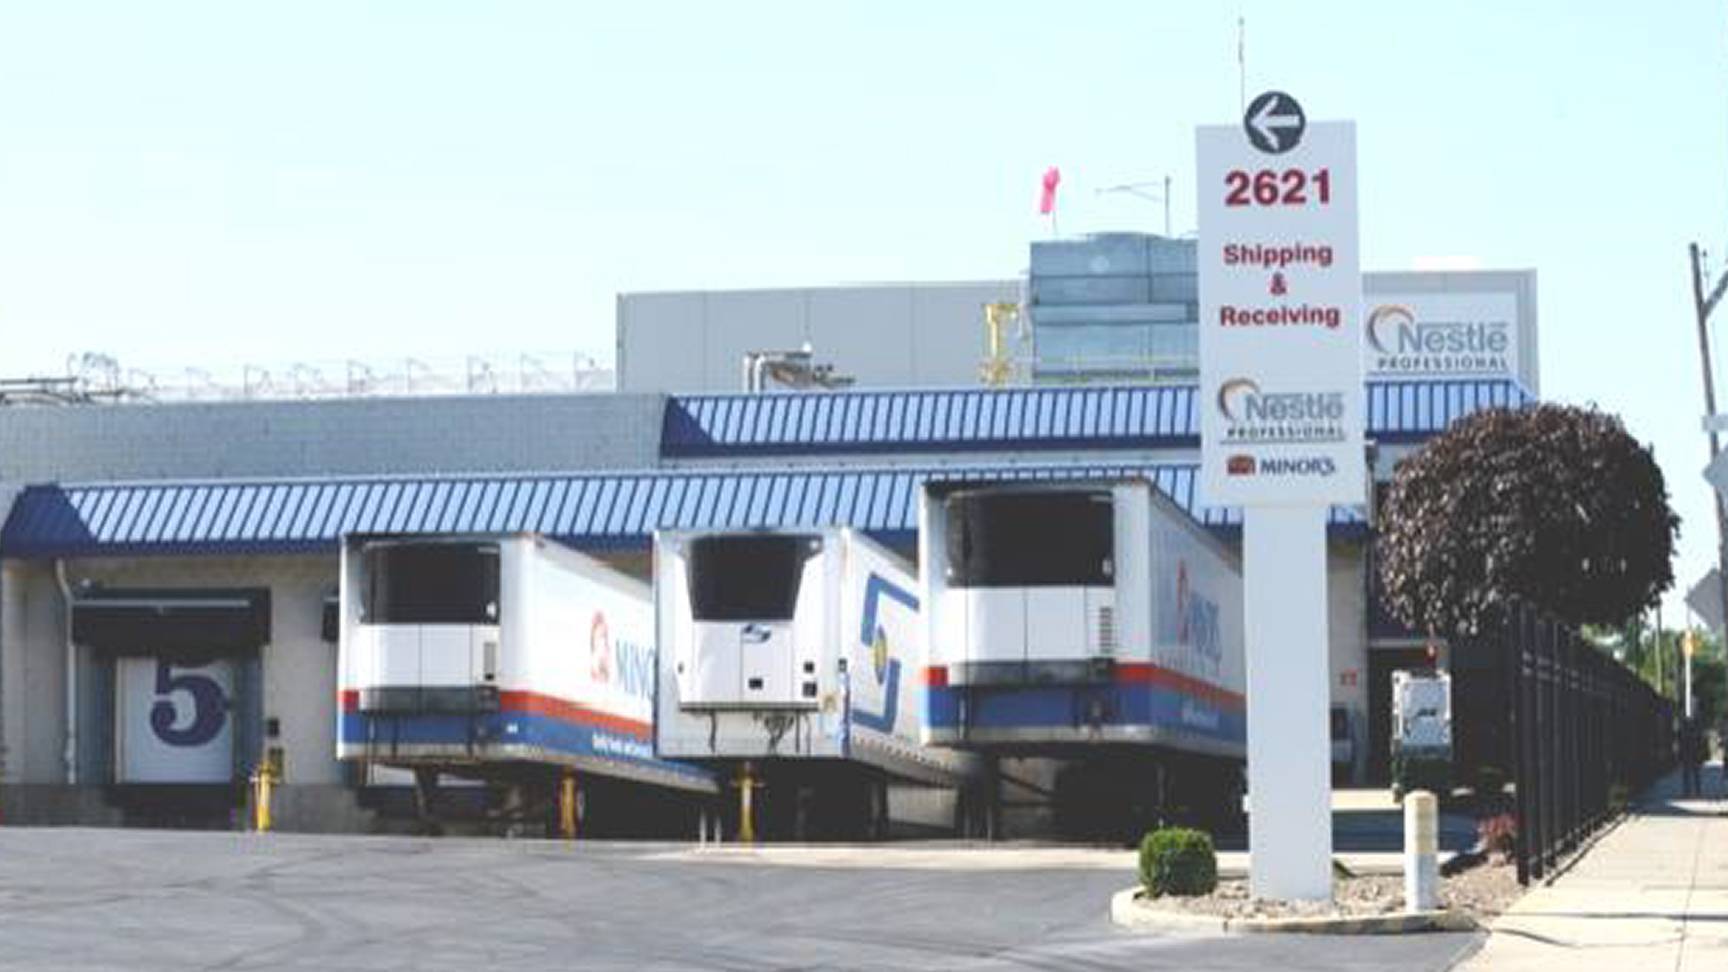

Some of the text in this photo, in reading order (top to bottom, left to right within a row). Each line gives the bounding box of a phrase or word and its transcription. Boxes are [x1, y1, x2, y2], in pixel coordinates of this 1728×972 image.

[1225, 169, 1331, 205] 2621
[1224, 241, 1333, 268] Shipping
[1270, 272, 1287, 296] &
[1220, 304, 1341, 329] Receiving
[1378, 356, 1508, 369] PROFESSIONAL
[1226, 426, 1344, 438] PROFESSIONAL
[151, 656, 230, 747] 5
